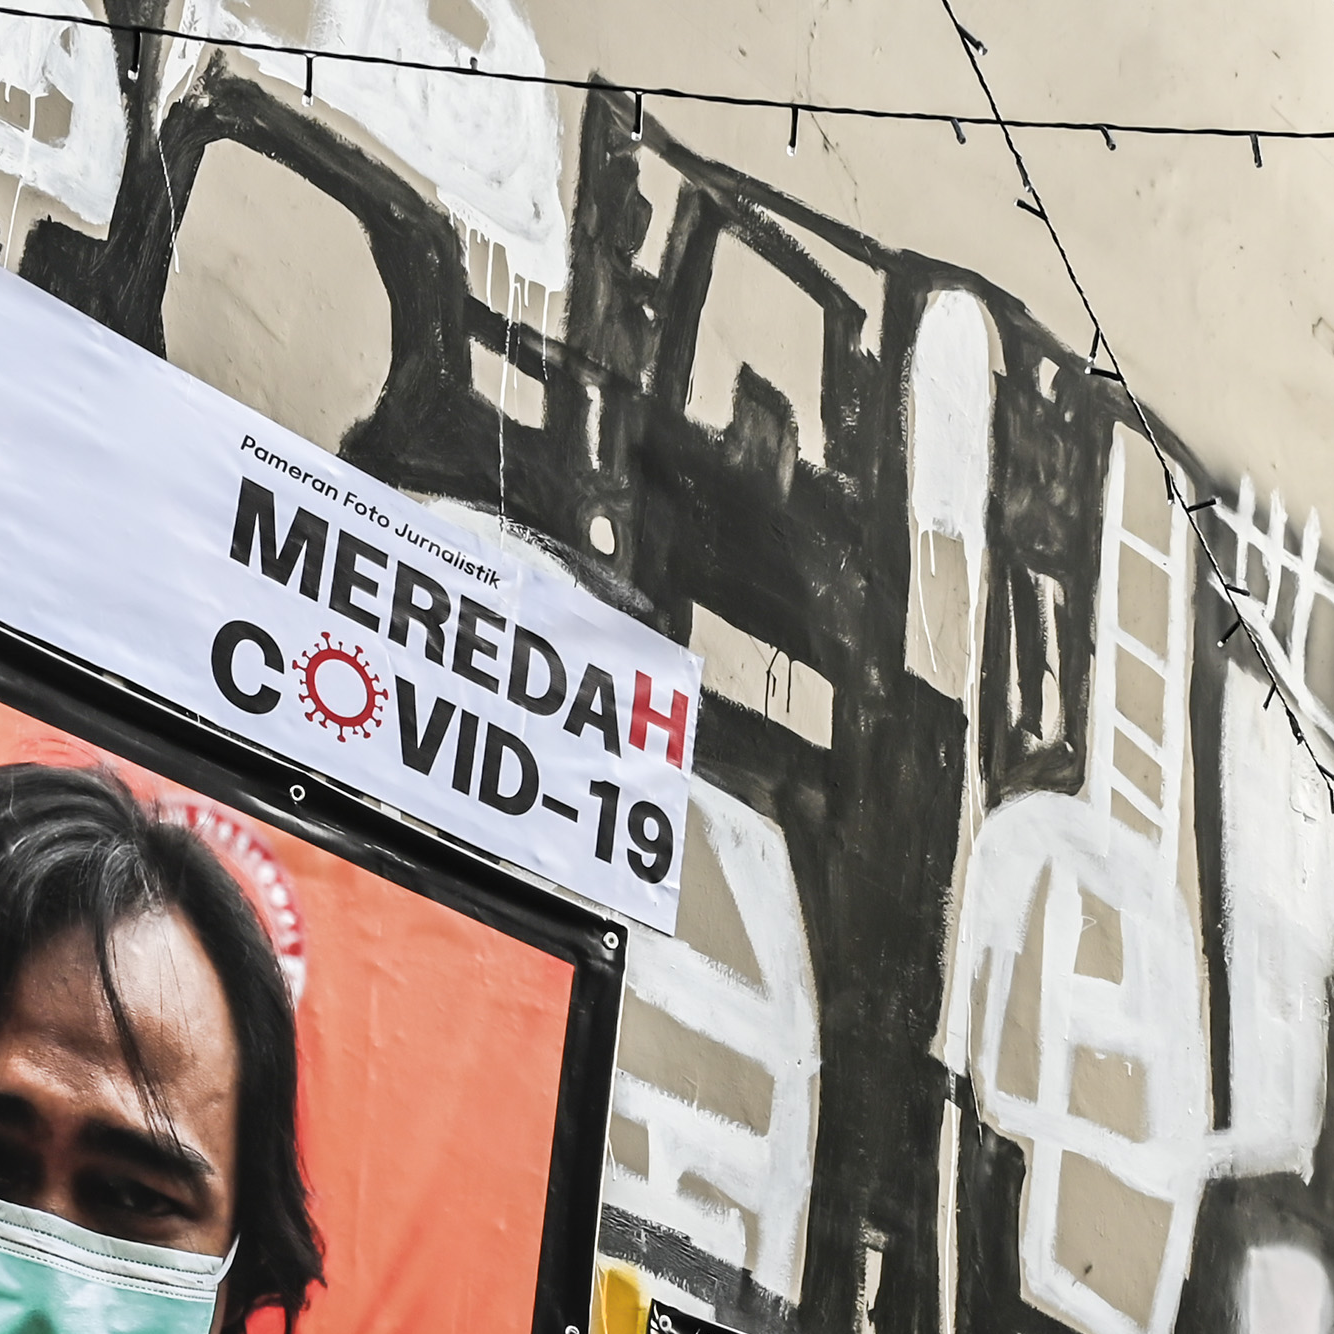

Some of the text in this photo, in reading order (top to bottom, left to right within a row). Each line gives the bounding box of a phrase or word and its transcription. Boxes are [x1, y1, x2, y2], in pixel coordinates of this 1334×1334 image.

[229, 476, 689, 769] MEREDAH
[240, 434, 501, 590] Pameran Foto Jurnalistik
[211, 619, 674, 884] COVID-19
